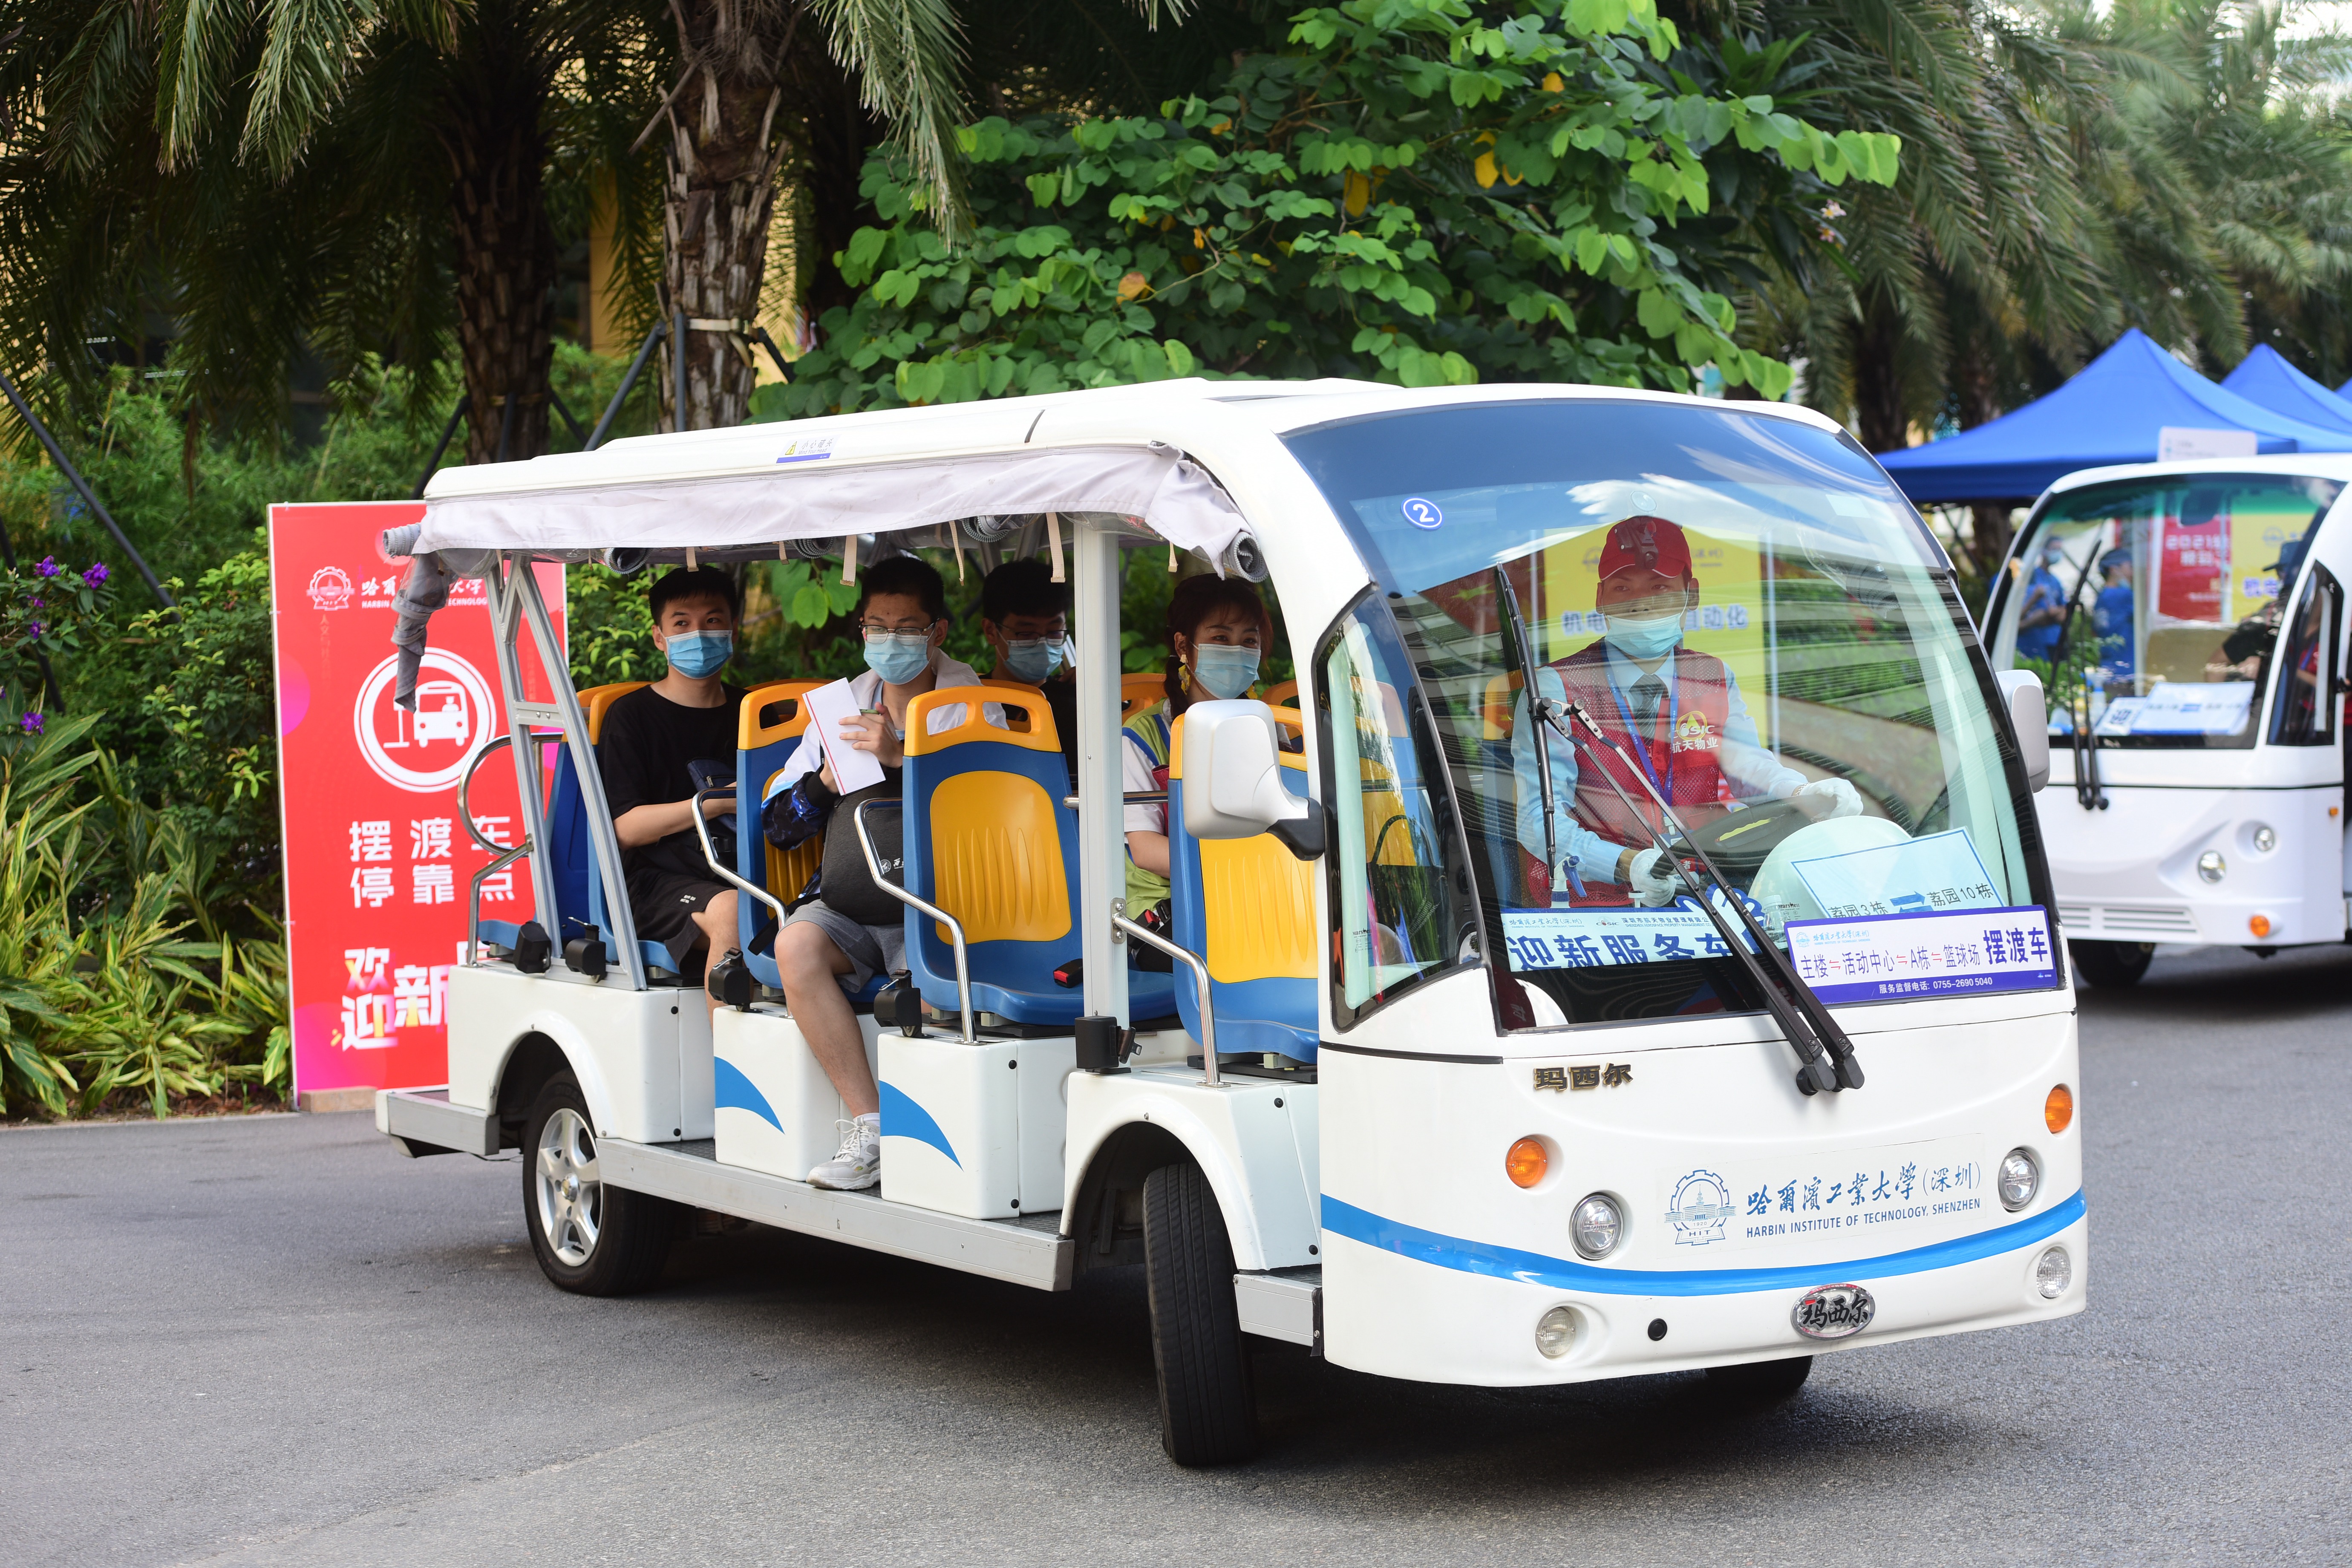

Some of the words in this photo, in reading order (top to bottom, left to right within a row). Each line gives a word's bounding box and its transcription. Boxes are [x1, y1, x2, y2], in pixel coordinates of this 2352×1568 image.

[1413, 504, 1435, 522] 2
[362, 599, 390, 608] HARBIN
[447, 597, 488, 606] ECHNOLOG
[1670, 737, 1718, 753] 航天物业
[349, 816, 512, 862] 摆渡车
[350, 863, 515, 908] 停靠点
[1927, 882, 1994, 908] 荔园10栋
[1801, 954, 1829, 979] 主楼
[1842, 949, 1895, 976] 活动中心
[1910, 945, 1931, 971] A栋
[1943, 943, 1980, 968] 篮球场
[1983, 926, 2048, 965] 摆渡车
[1533, 1063, 1634, 1091] 玛西尔
[1747, 1223, 1785, 1238] HARBIN
[1790, 1217, 1841, 1233] INSTITUTE
[1846, 1214, 1859, 1226] OF
[1864, 1205, 1928, 1224] TECHNOLOGY,
[1932, 1198, 1980, 1215] SHENZHEN
[1802, 1293, 1869, 1328] 玛西尔
